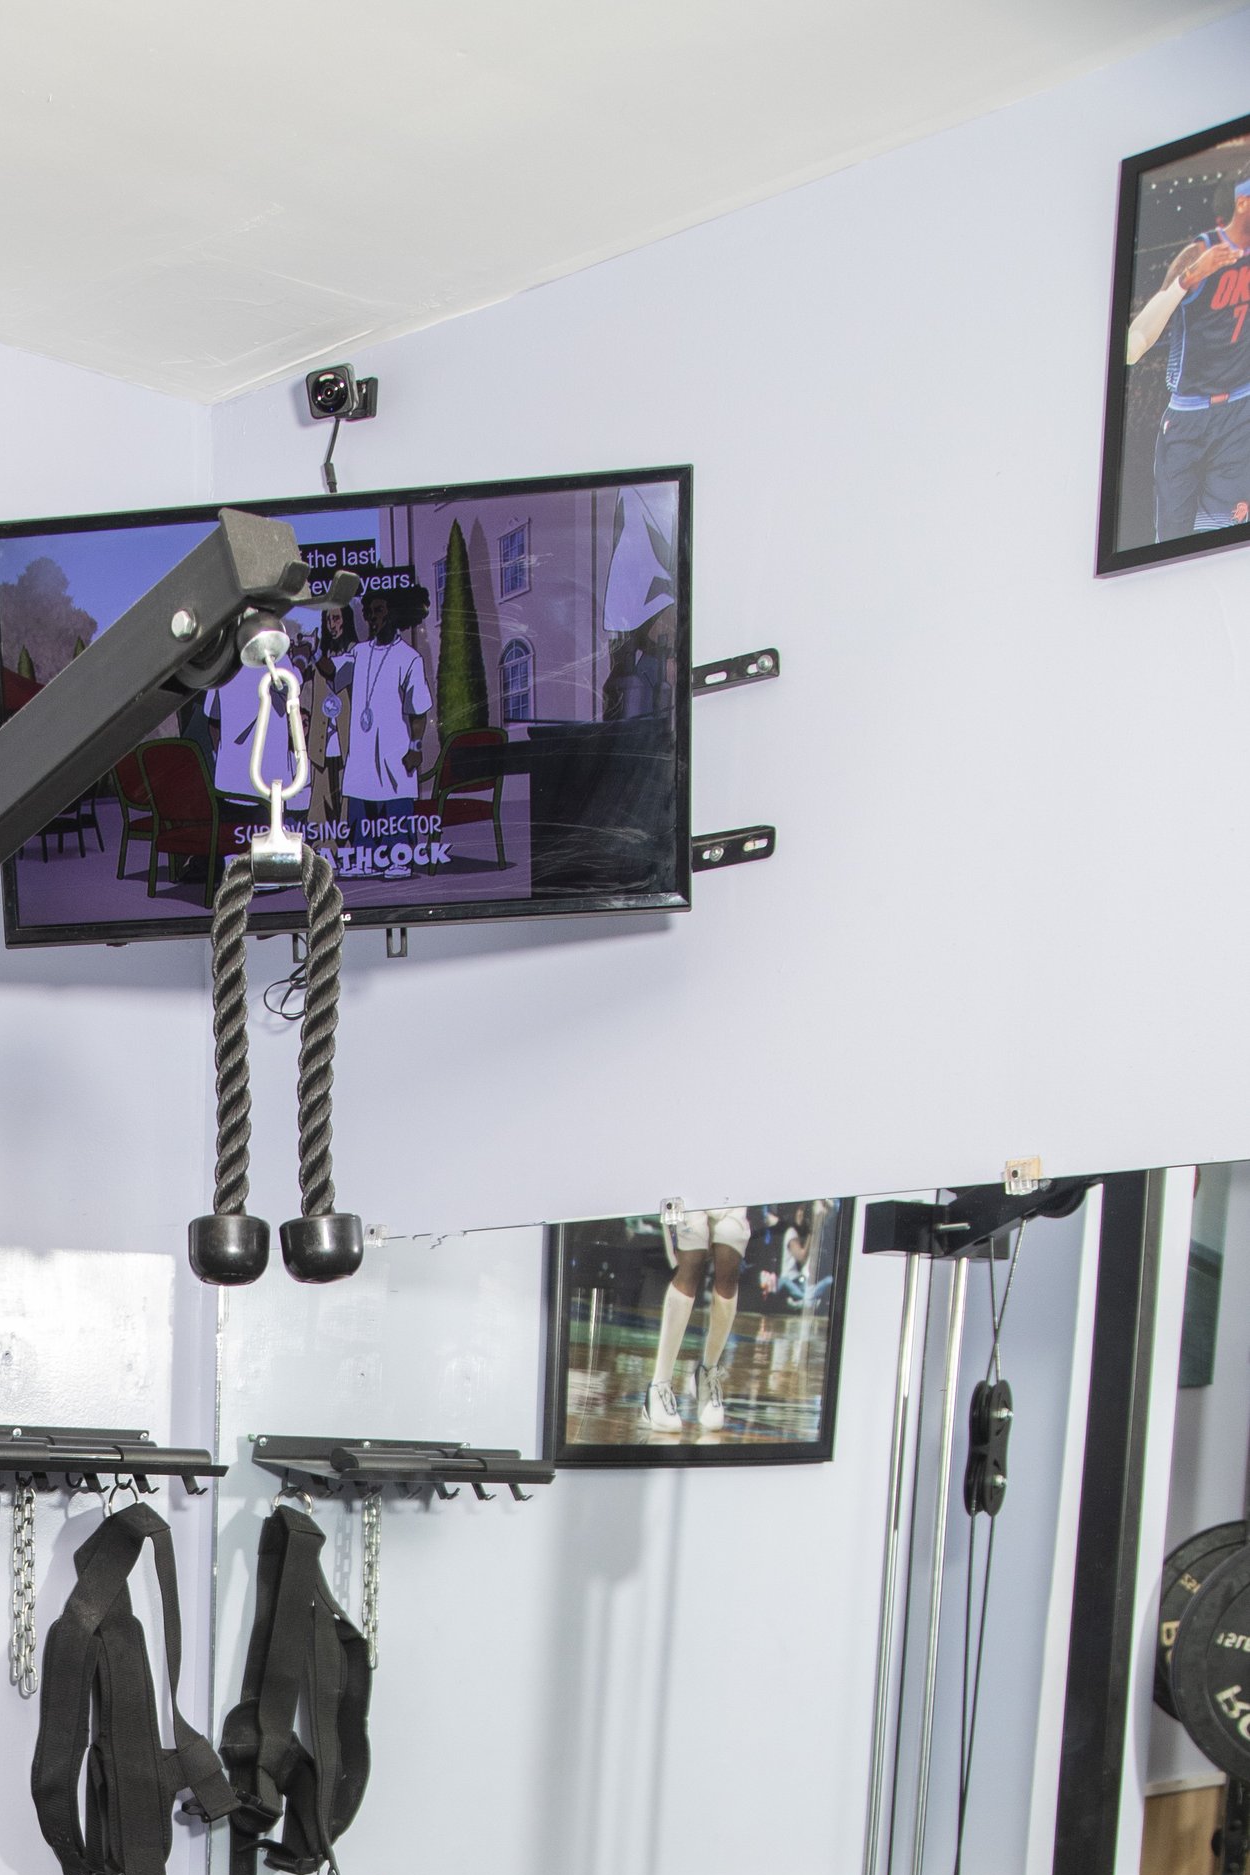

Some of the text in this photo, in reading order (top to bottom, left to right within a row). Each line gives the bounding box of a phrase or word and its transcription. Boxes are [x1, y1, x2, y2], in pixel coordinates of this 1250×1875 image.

[1232, 304, 1248, 344] 7
[307, 546, 377, 568] the last
[360, 573, 415, 596] years.
[361, 815, 443, 838] DIRECTOR
[319, 842, 452, 869] ATHCOCK
